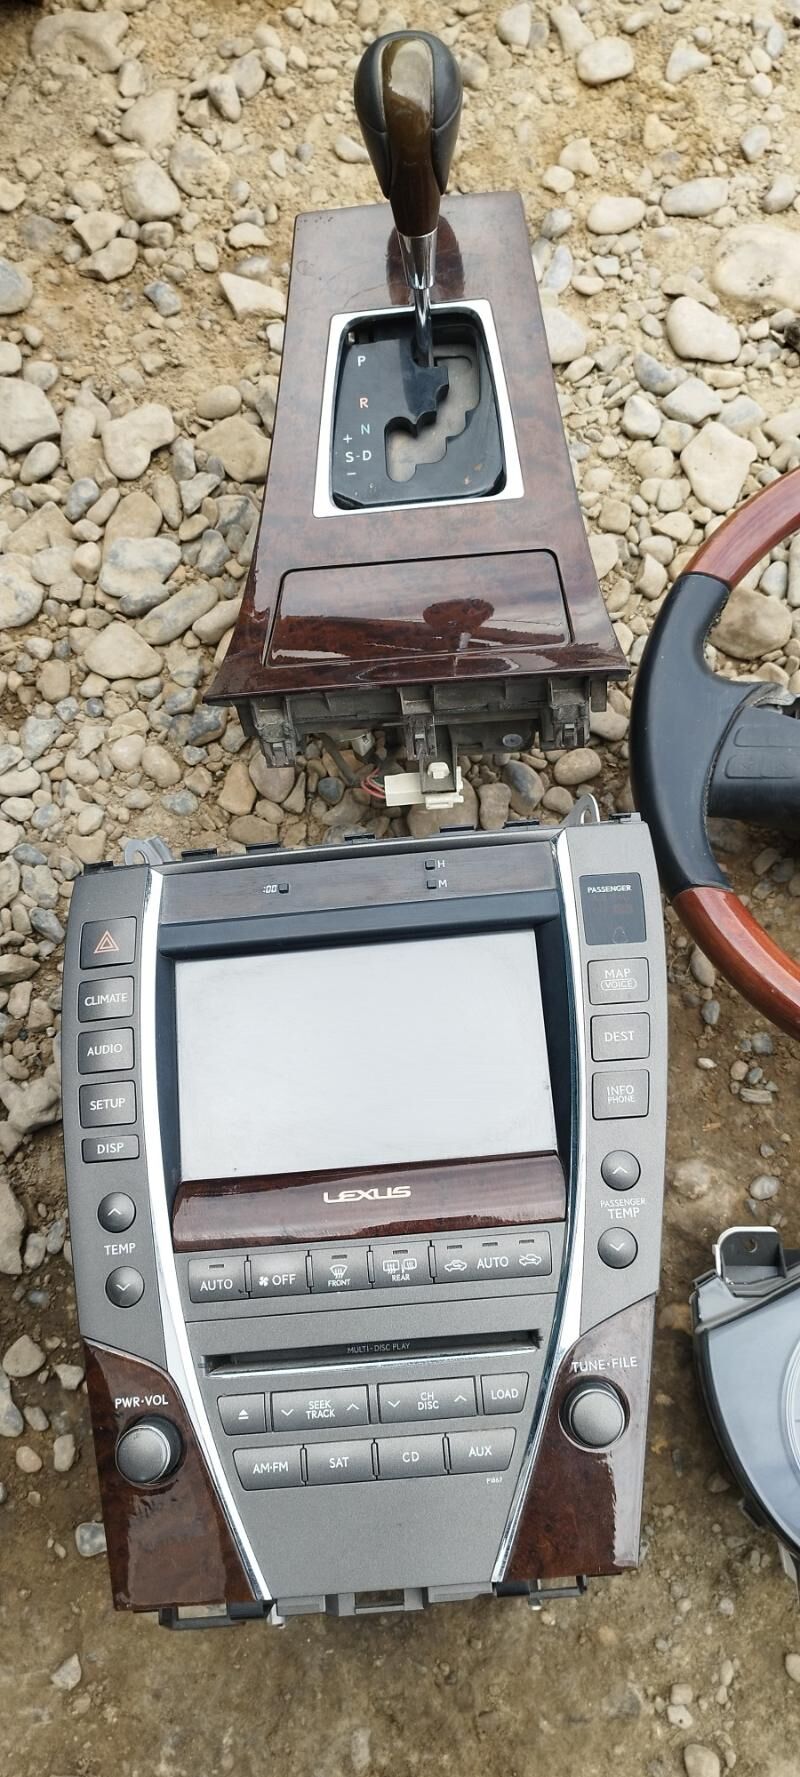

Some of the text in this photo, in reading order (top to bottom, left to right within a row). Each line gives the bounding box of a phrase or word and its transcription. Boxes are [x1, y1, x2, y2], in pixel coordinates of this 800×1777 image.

[357, 356, 366, 367] P
[360, 398, 369, 408] R
[361, 424, 370, 435] N
[437, 860, 445, 868] H
[438, 879, 448, 887] M
[587, 884, 632, 893] PASSENGER
[604, 968, 631, 979] MAP
[605, 980, 633, 988] VOICE
[84, 992, 128, 1006] CLIMATE
[604, 1031, 635, 1042] DEST
[87, 1043, 123, 1056] AUDIO
[607, 1085, 635, 1096] INFO
[89, 1097, 126, 1111] SETUP
[607, 1095, 635, 1104] PHONE
[97, 1142, 124, 1154] DISP
[323, 1186, 411, 1203] LEXUS
[600, 1197, 646, 1208] PASSENGER
[607, 1207, 640, 1219] TEMP
[104, 1242, 136, 1256] TEMP
[477, 1256, 509, 1269] AUTO
[272, 1273, 297, 1286] OFF
[327, 1278, 351, 1287] FRONT
[391, 1272, 411, 1282] REAR
[200, 1279, 233, 1291] AUTO
[346, 1343, 410, 1353] MULTI-DISC PLAY
[420, 1391, 435, 1400] CH
[490, 1388, 519, 1401] LOAD
[308, 1400, 332, 1410] SEEK
[417, 1401, 440, 1411] DISC
[306, 1408, 336, 1419] TRACK
[402, 1451, 420, 1463] CD
[468, 1445, 493, 1458] AUX
[328, 1456, 349, 1468] SAT
